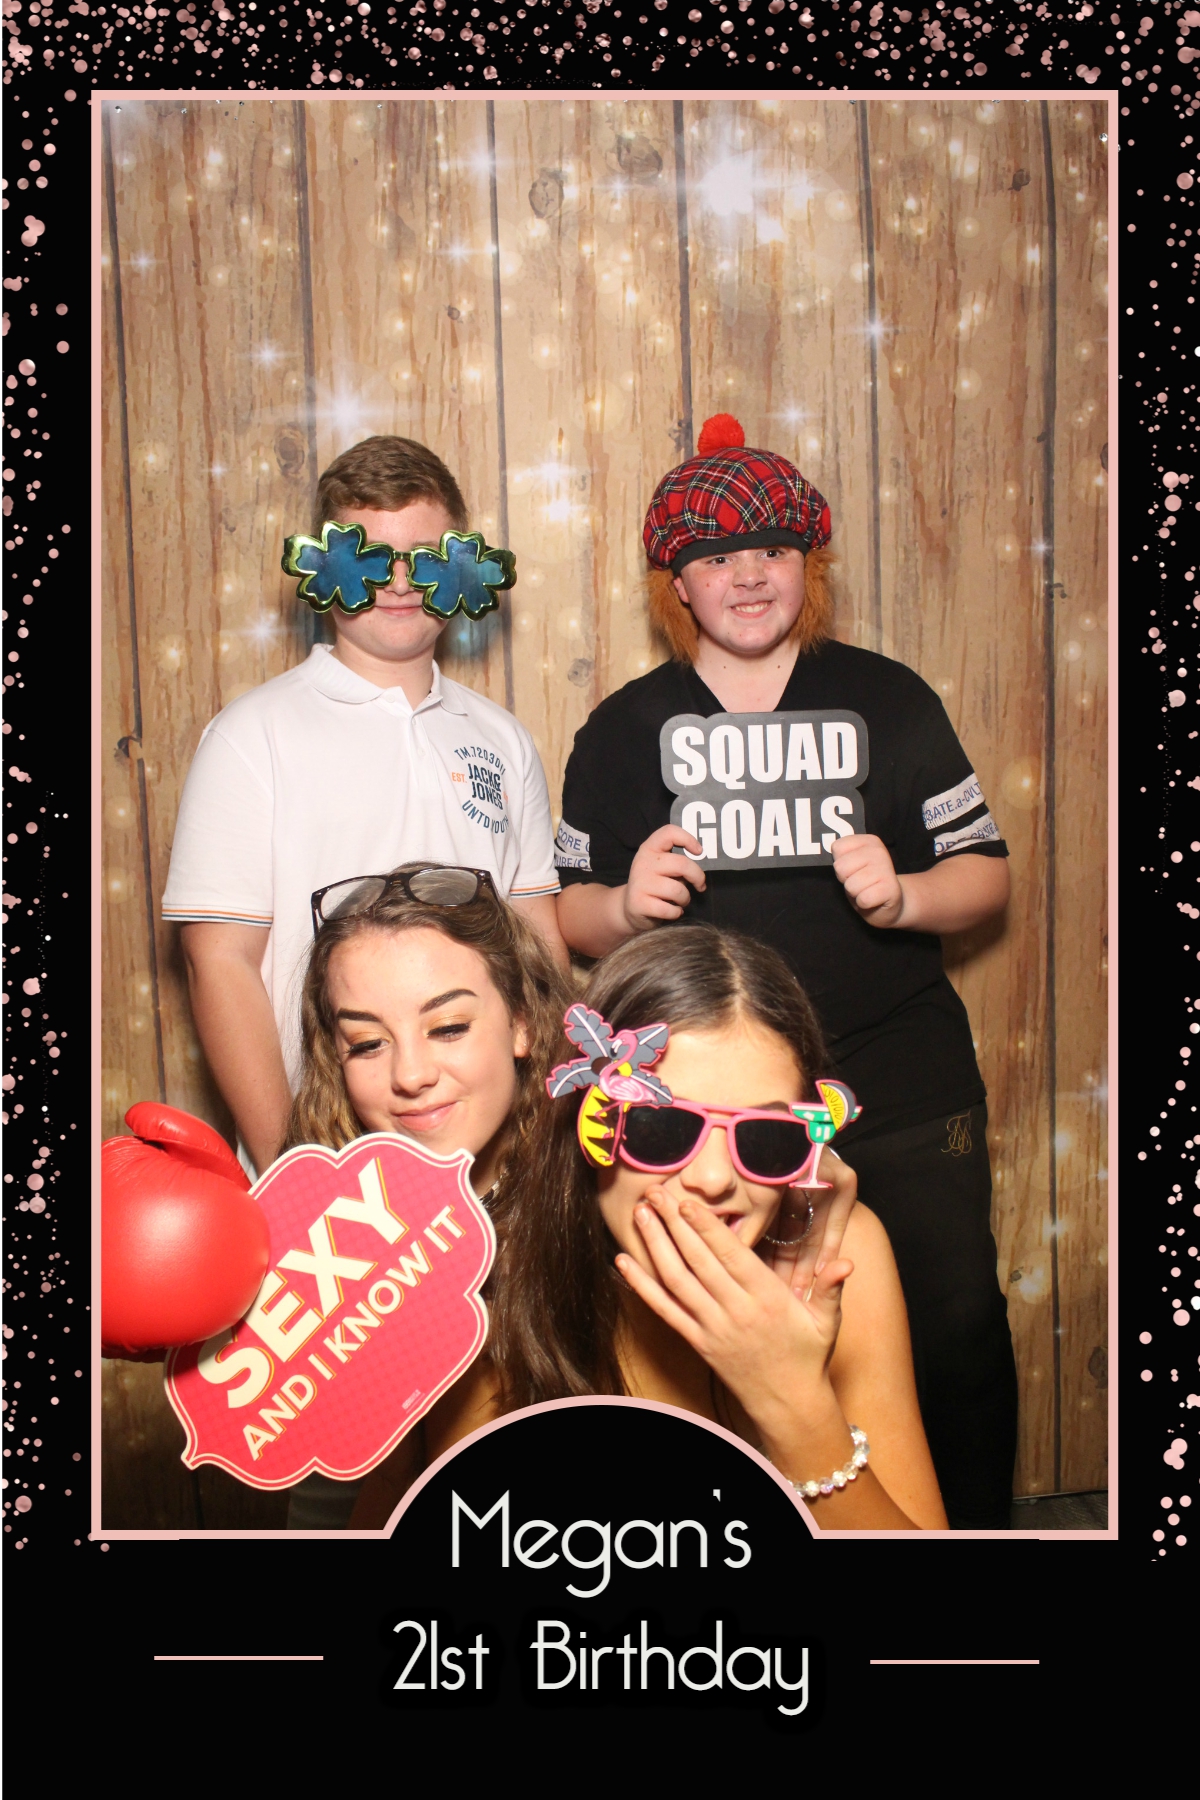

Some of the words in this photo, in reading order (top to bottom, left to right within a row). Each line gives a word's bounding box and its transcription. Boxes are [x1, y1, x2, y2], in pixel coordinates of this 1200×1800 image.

[671, 722, 858, 790] SQUAD
[462, 799, 491, 829] UNTD
[471, 781, 504, 810] JONES
[681, 795, 855, 861] GOALS
[197, 1157, 409, 1409] SEXY
[243, 1374, 317, 1461] AND
[307, 1353, 336, 1381] I
[323, 1240, 433, 1363] KNOW
[423, 1205, 466, 1253] IT
